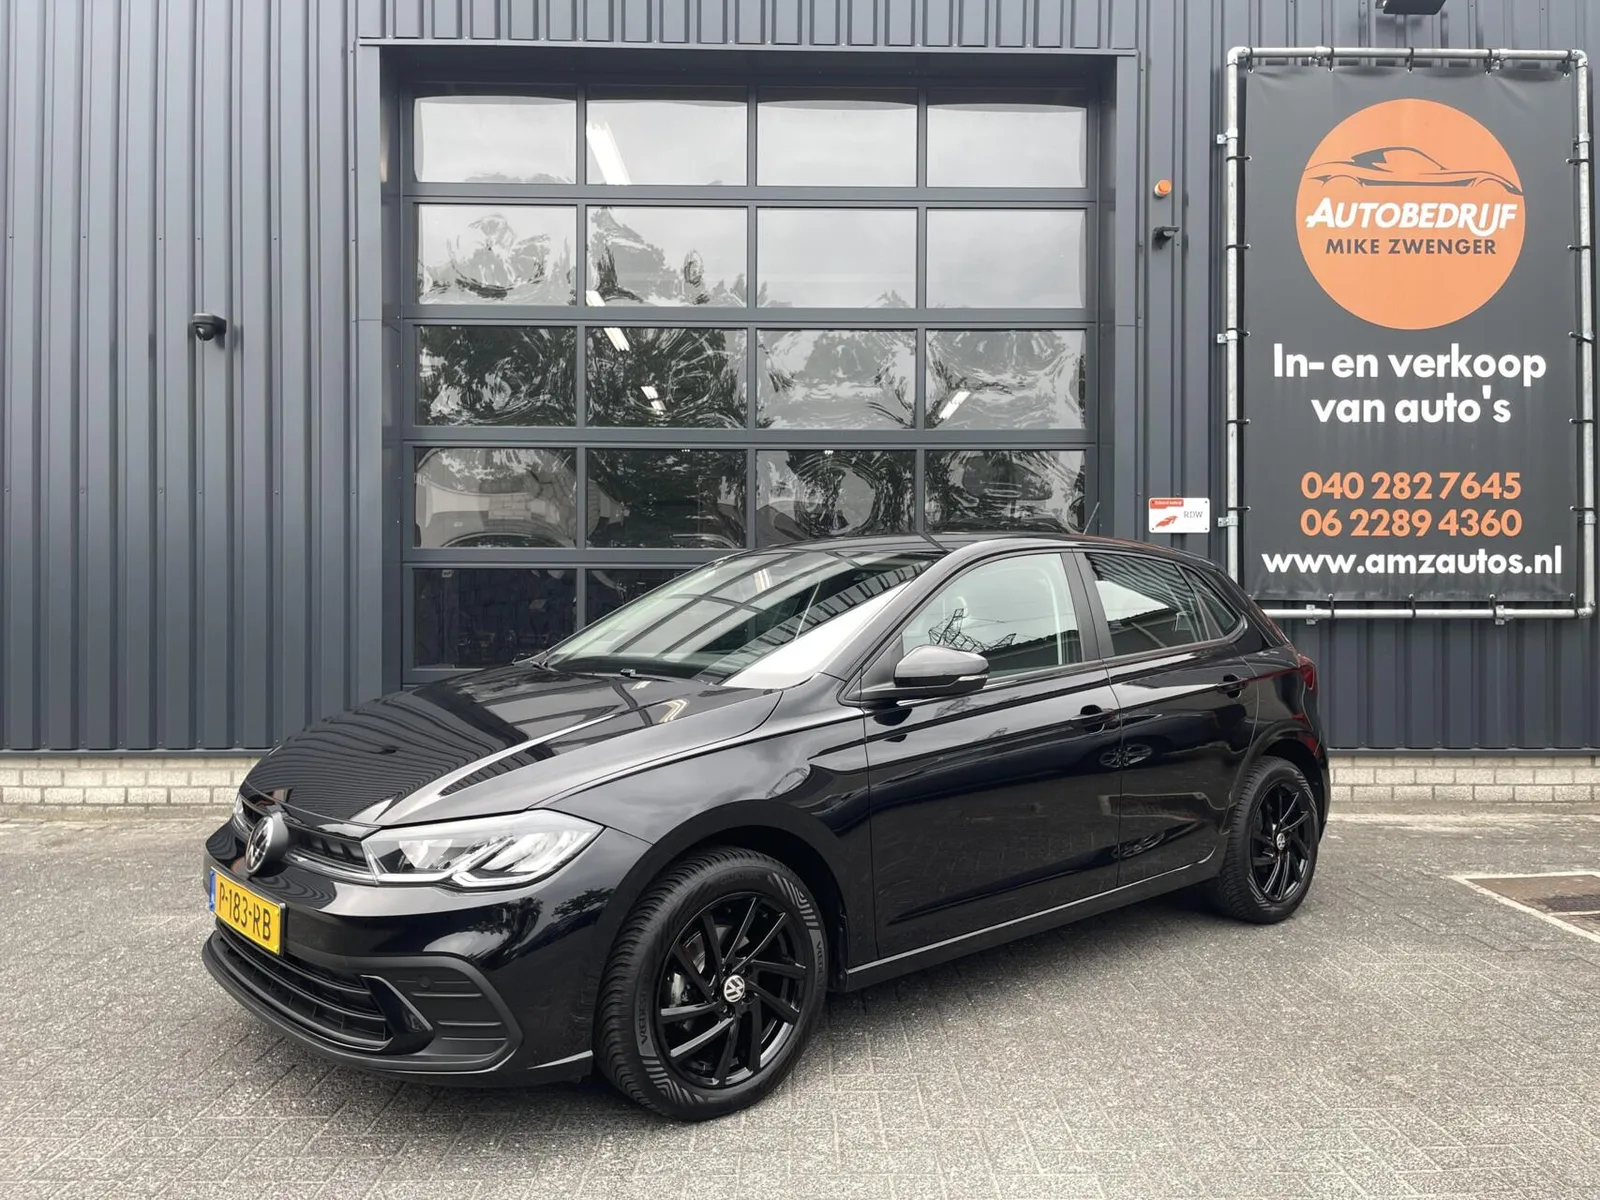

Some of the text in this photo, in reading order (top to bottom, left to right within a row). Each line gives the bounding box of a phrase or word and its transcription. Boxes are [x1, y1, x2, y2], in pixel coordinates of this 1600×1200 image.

[1305, 197, 1518, 237] AUTOBEDRIJF
[1326, 238, 1496, 255] MIKE ZWENGER
[1273, 342, 1547, 388] In- en verkoop
[1310, 384, 1512, 423] van auto's
[1301, 471, 1522, 500] 040 282 7645
[1183, 510, 1203, 519] RDW
[1300, 508, 1523, 537] 06 2289 4360
[1261, 545, 1562, 575] www.amzautos.nl
[218, 882, 271, 941] P-183-RB
